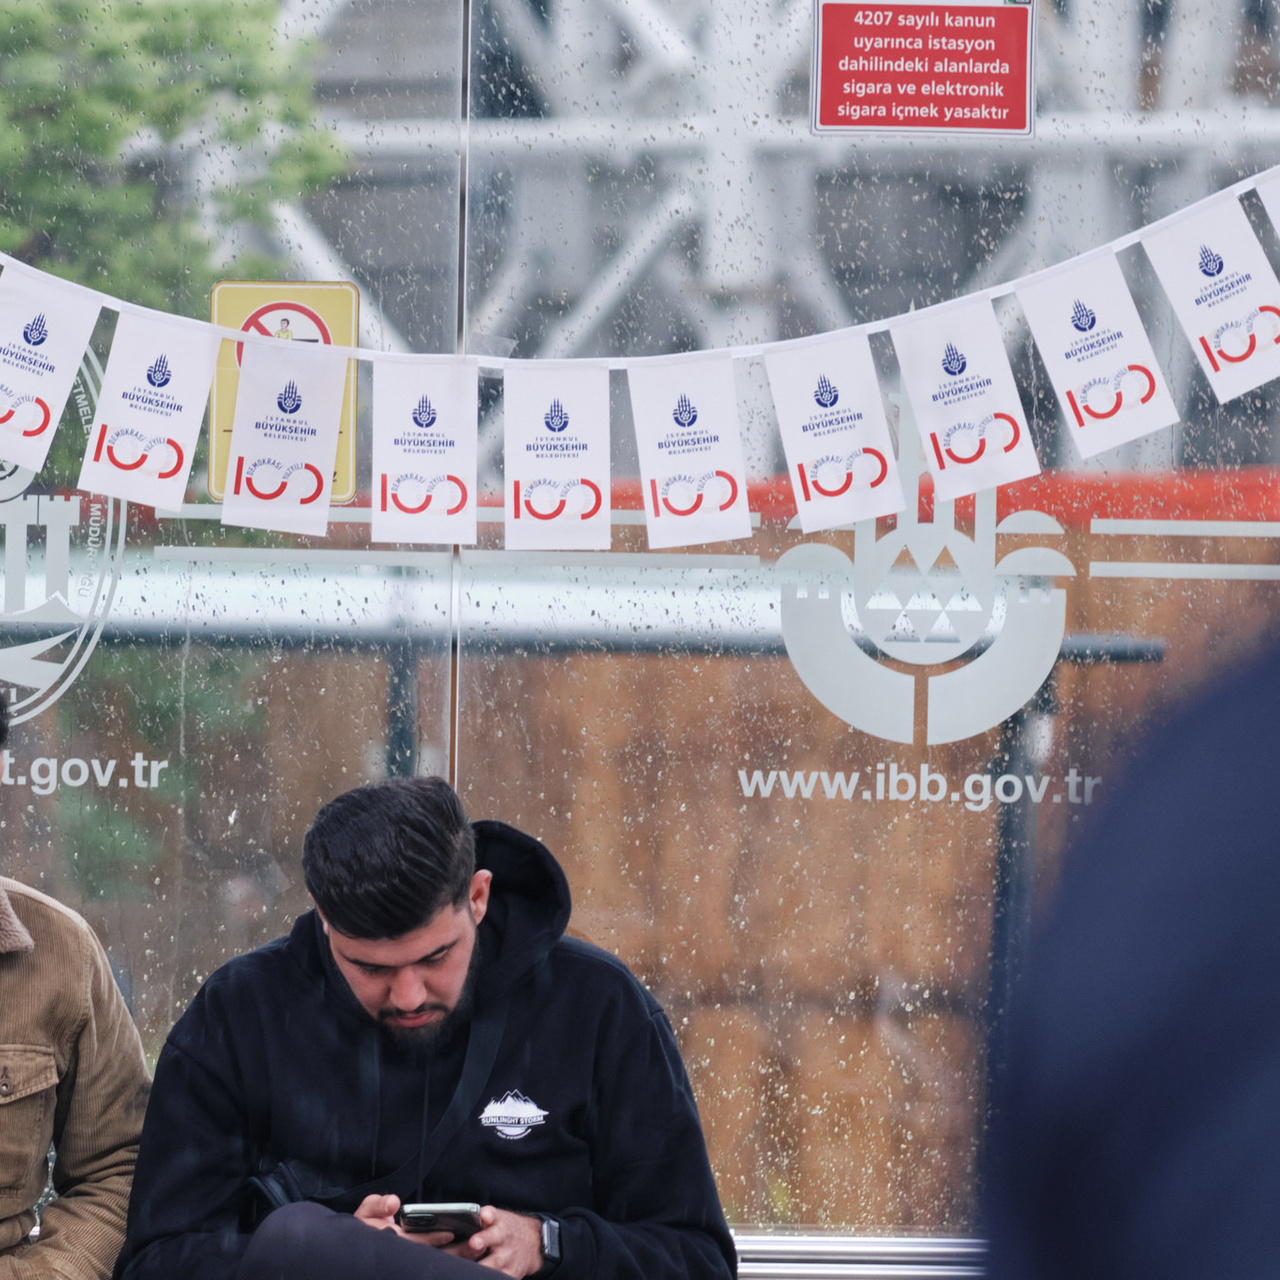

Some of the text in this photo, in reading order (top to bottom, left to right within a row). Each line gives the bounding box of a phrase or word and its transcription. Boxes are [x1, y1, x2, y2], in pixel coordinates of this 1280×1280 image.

[854, 11, 996, 30] 4207 sayılı kanun
[854, 35, 995, 53] uyarınca istasyon
[838, 56, 1010, 74] dahilindeki alanlarda
[843, 79, 1004, 97] sigara ve elektronik
[838, 102, 1009, 121] sigara içmek yasaktır
[1193, 271, 1253, 306] BÜYÜKŞEHİR
[1063, 329, 1124, 360] BÜYÜKŞEHİR
[931, 377, 993, 402] BÜYÜKŞEHİR
[121, 389, 183, 413] BÜYÜKŞEHİR
[254, 419, 317, 437] BÜYÜKŞEHİR
[801, 411, 863, 433] BÜYÜKŞEHİR
[393, 436, 454, 448] BÜYÜKŞEHİR
[526, 442, 587, 451] BÜYÜKŞEHİR
[657, 434, 719, 450] BÜYÜKŞEHİR
[1, 749, 169, 795] t.gov.tr
[738, 763, 1102, 812] www.ibb.gov.tr
